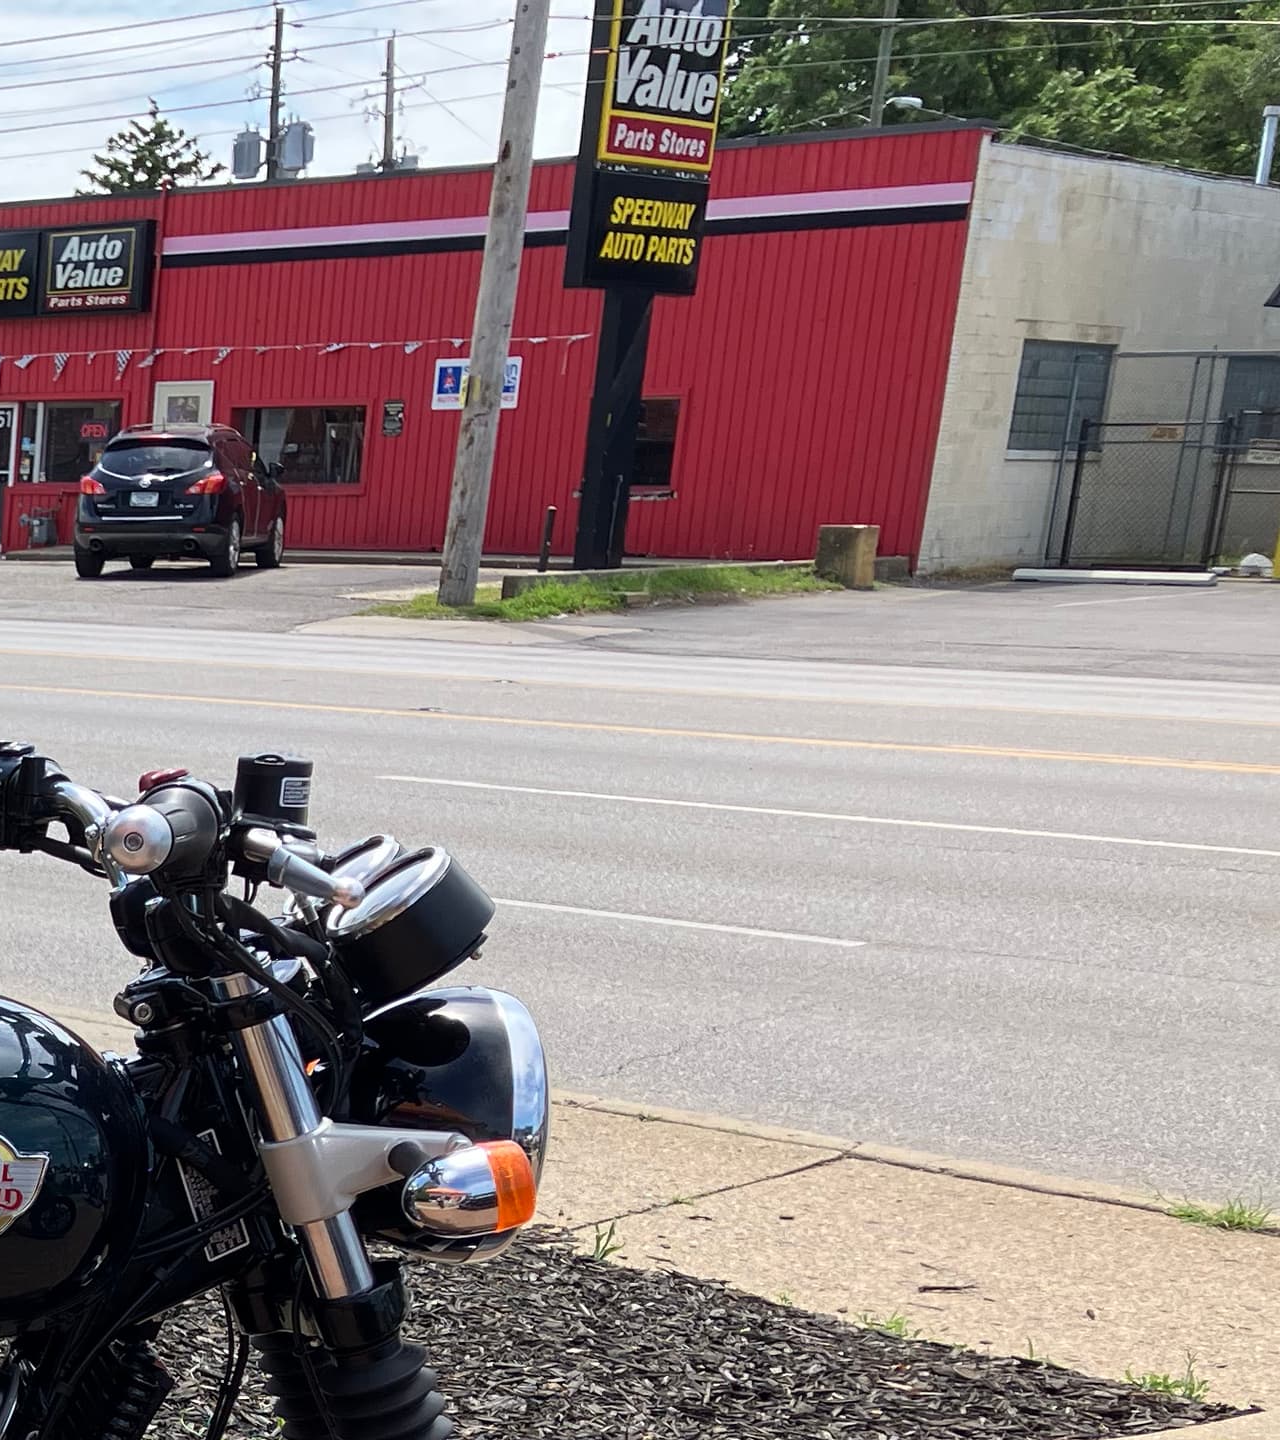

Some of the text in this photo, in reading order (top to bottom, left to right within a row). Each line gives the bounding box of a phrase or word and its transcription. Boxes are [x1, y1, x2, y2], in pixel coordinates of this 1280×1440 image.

[627, 0, 723, 57] Auto
[616, 46, 718, 115] Value
[614, 123, 706, 158] Parts Stores
[611, 196, 696, 230] SPEEDWAY
[60, 235, 123, 263] Auto
[600, 231, 696, 265] AUTO PARTS
[55, 262, 124, 289] Value
[49, 294, 127, 308] Parts Stores
[80, 424, 108, 438] OPEN
